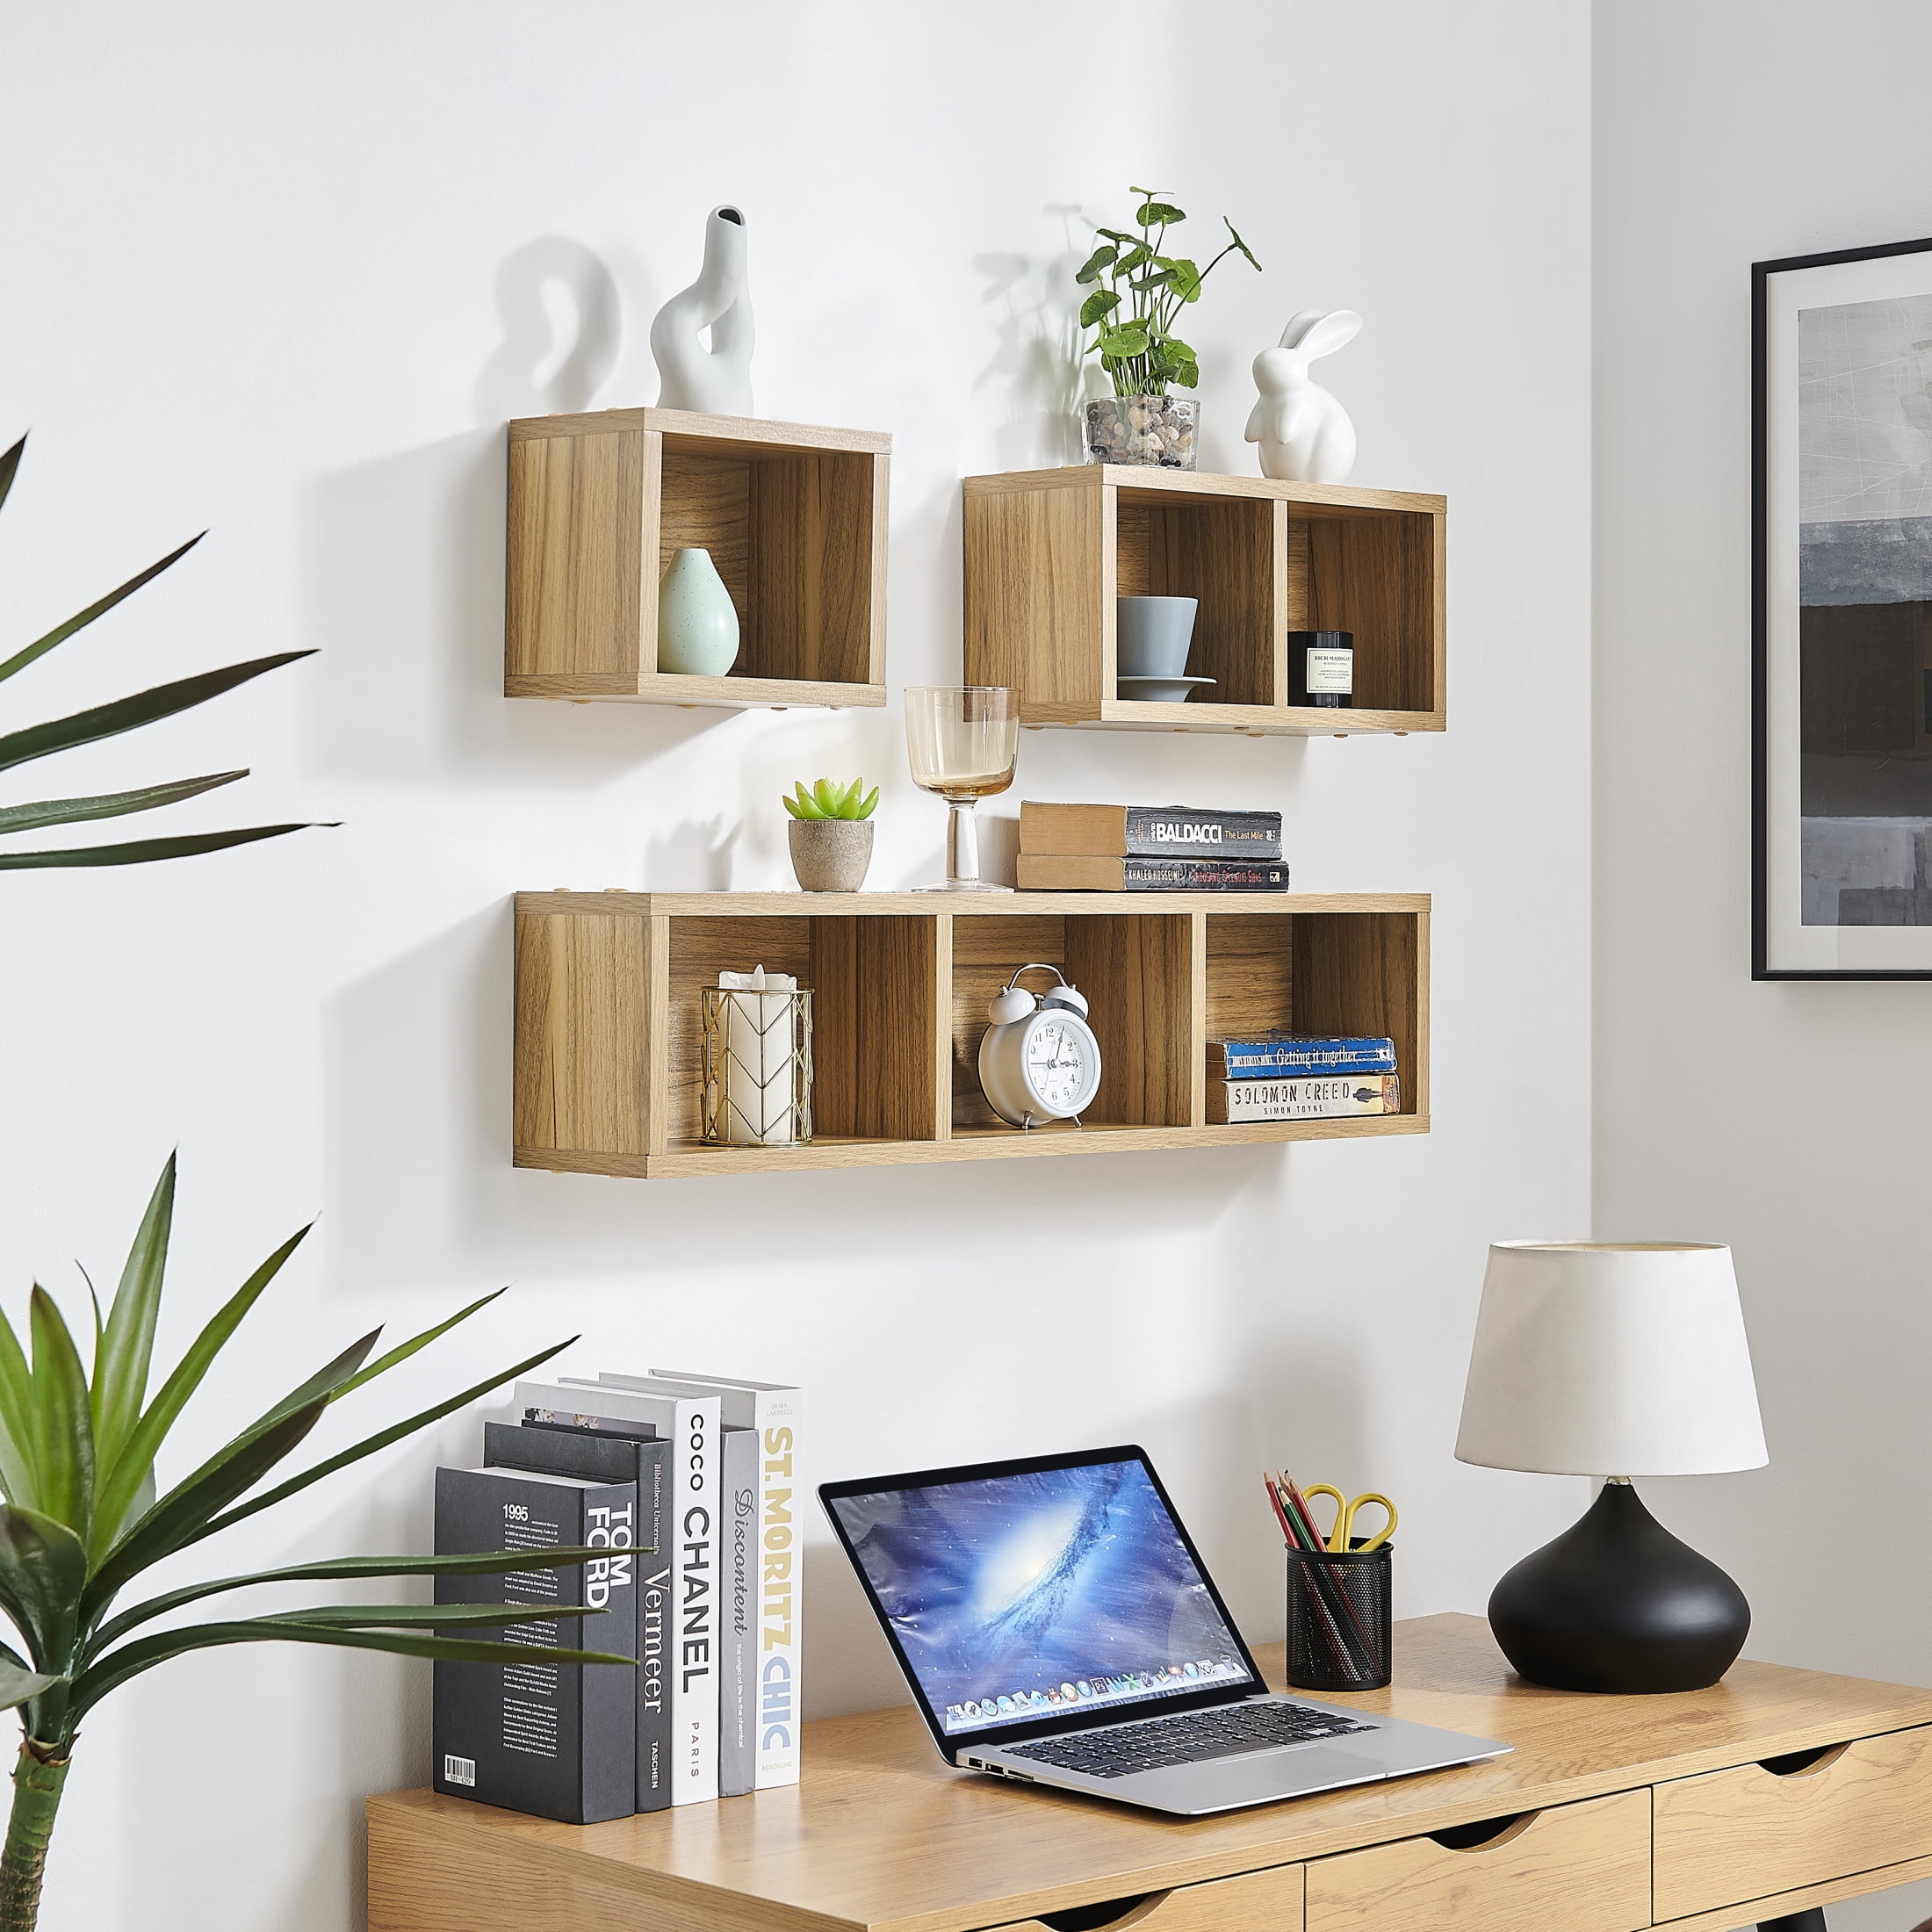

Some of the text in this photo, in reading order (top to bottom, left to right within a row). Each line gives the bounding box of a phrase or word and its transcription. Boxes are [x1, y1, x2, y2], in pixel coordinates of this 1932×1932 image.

[1157, 822, 1222, 844] BALDACCI
[1224, 830, 1236, 840] The
[1236, 830, 1251, 840] Last
[1251, 831, 1264, 840] Mile
[1128, 869, 1180, 881] KHALED HOSSEINI
[1035, 1033, 1042, 1042] 11
[1046, 1028, 1054, 1037] 12
[1067, 1042, 1073, 1051] 2
[1072, 1058, 1078, 1069] 3
[1276, 1048, 1311, 1070] Getting
[1313, 1048, 1320, 1063] it
[1321, 1045, 1358, 1067] together
[1070, 1074, 1076, 1084] 4
[1051, 1092, 1058, 1101] 6
[1063, 1087, 1070, 1097] 5
[1235, 1082, 1351, 1106] SOLOMON CREED
[1264, 1104, 1323, 1115] SIMON TOYNE
[690, 1414, 704, 1491] COCO
[502, 1503, 529, 1522] 1995
[609, 1501, 632, 1587] TOM
[734, 1487, 754, 1637] Discontent
[762, 1426, 794, 1751] ST. MORITZ CHIC
[683, 1506, 710, 1694] CHANEL
[644, 1564, 671, 1714] Vermeer
[691, 1722, 700, 1777] PARIS
[651, 1740, 660, 1790] TASCHEN
